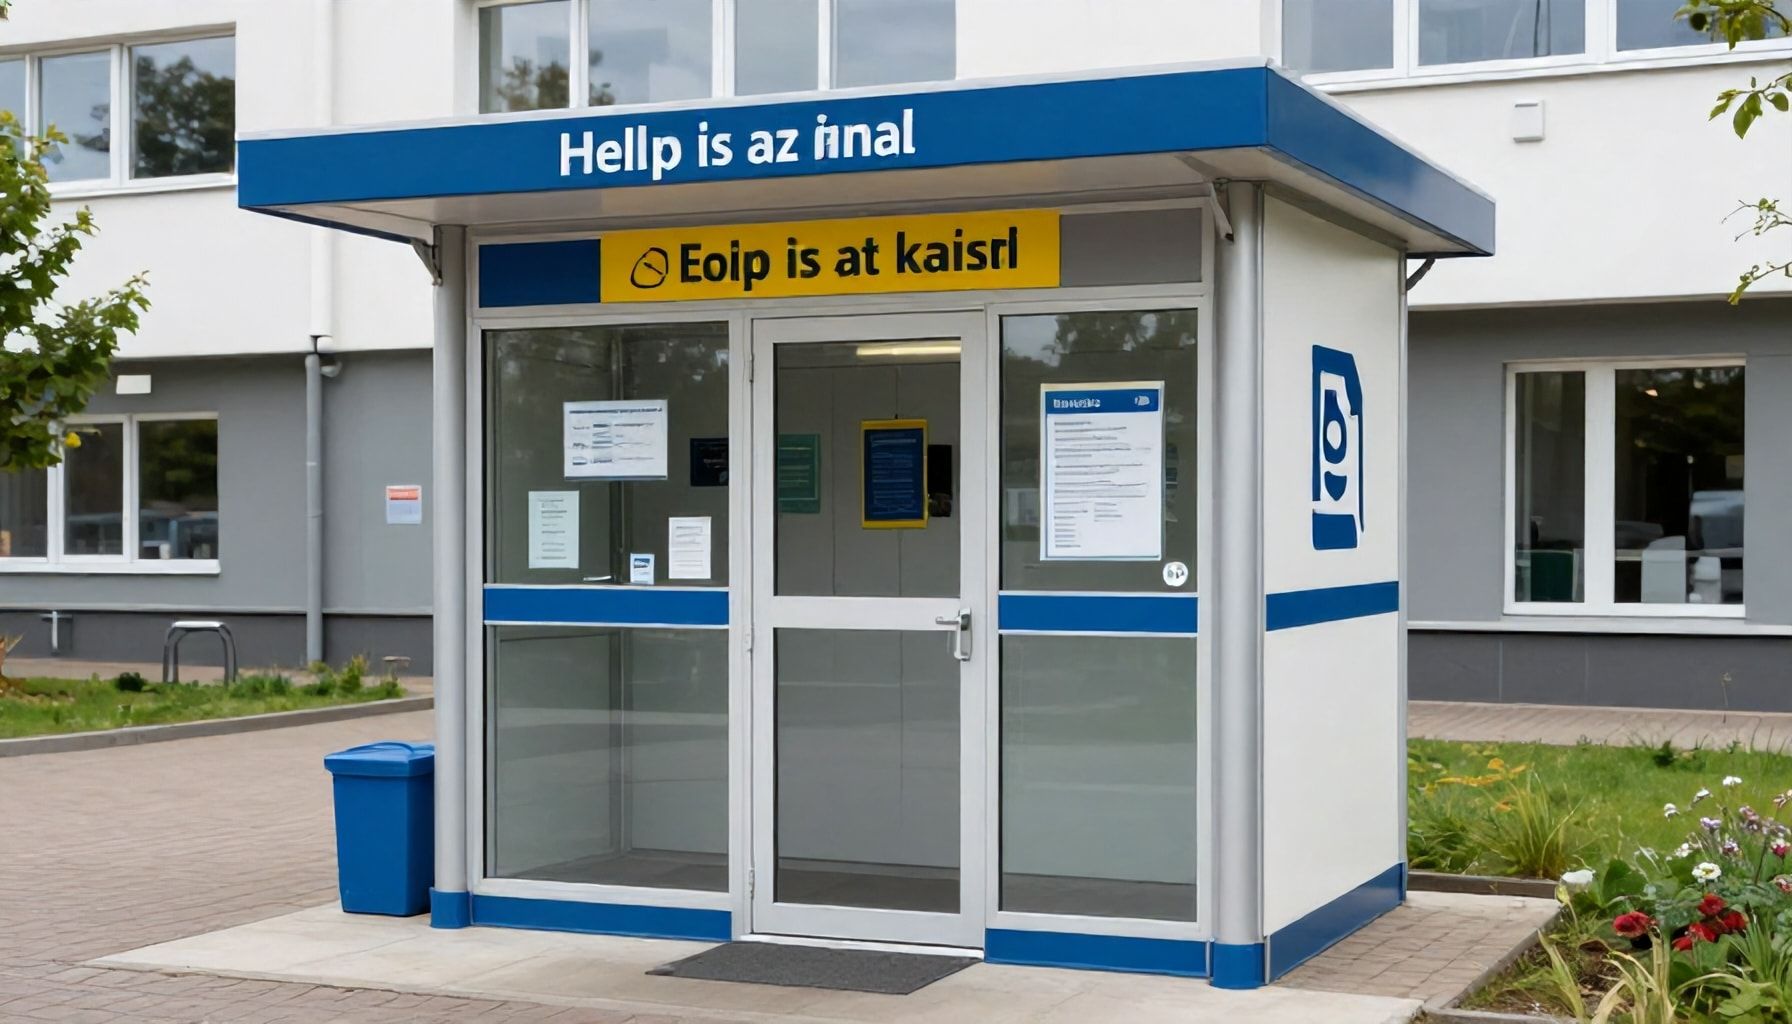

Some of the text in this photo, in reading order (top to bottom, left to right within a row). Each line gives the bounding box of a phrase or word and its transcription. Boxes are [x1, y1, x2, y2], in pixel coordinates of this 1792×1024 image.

[560, 126, 682, 181] Hellp
[698, 121, 734, 168] is
[747, 128, 799, 165] az
[786, 236, 822, 279] is
[833, 237, 880, 278] at
